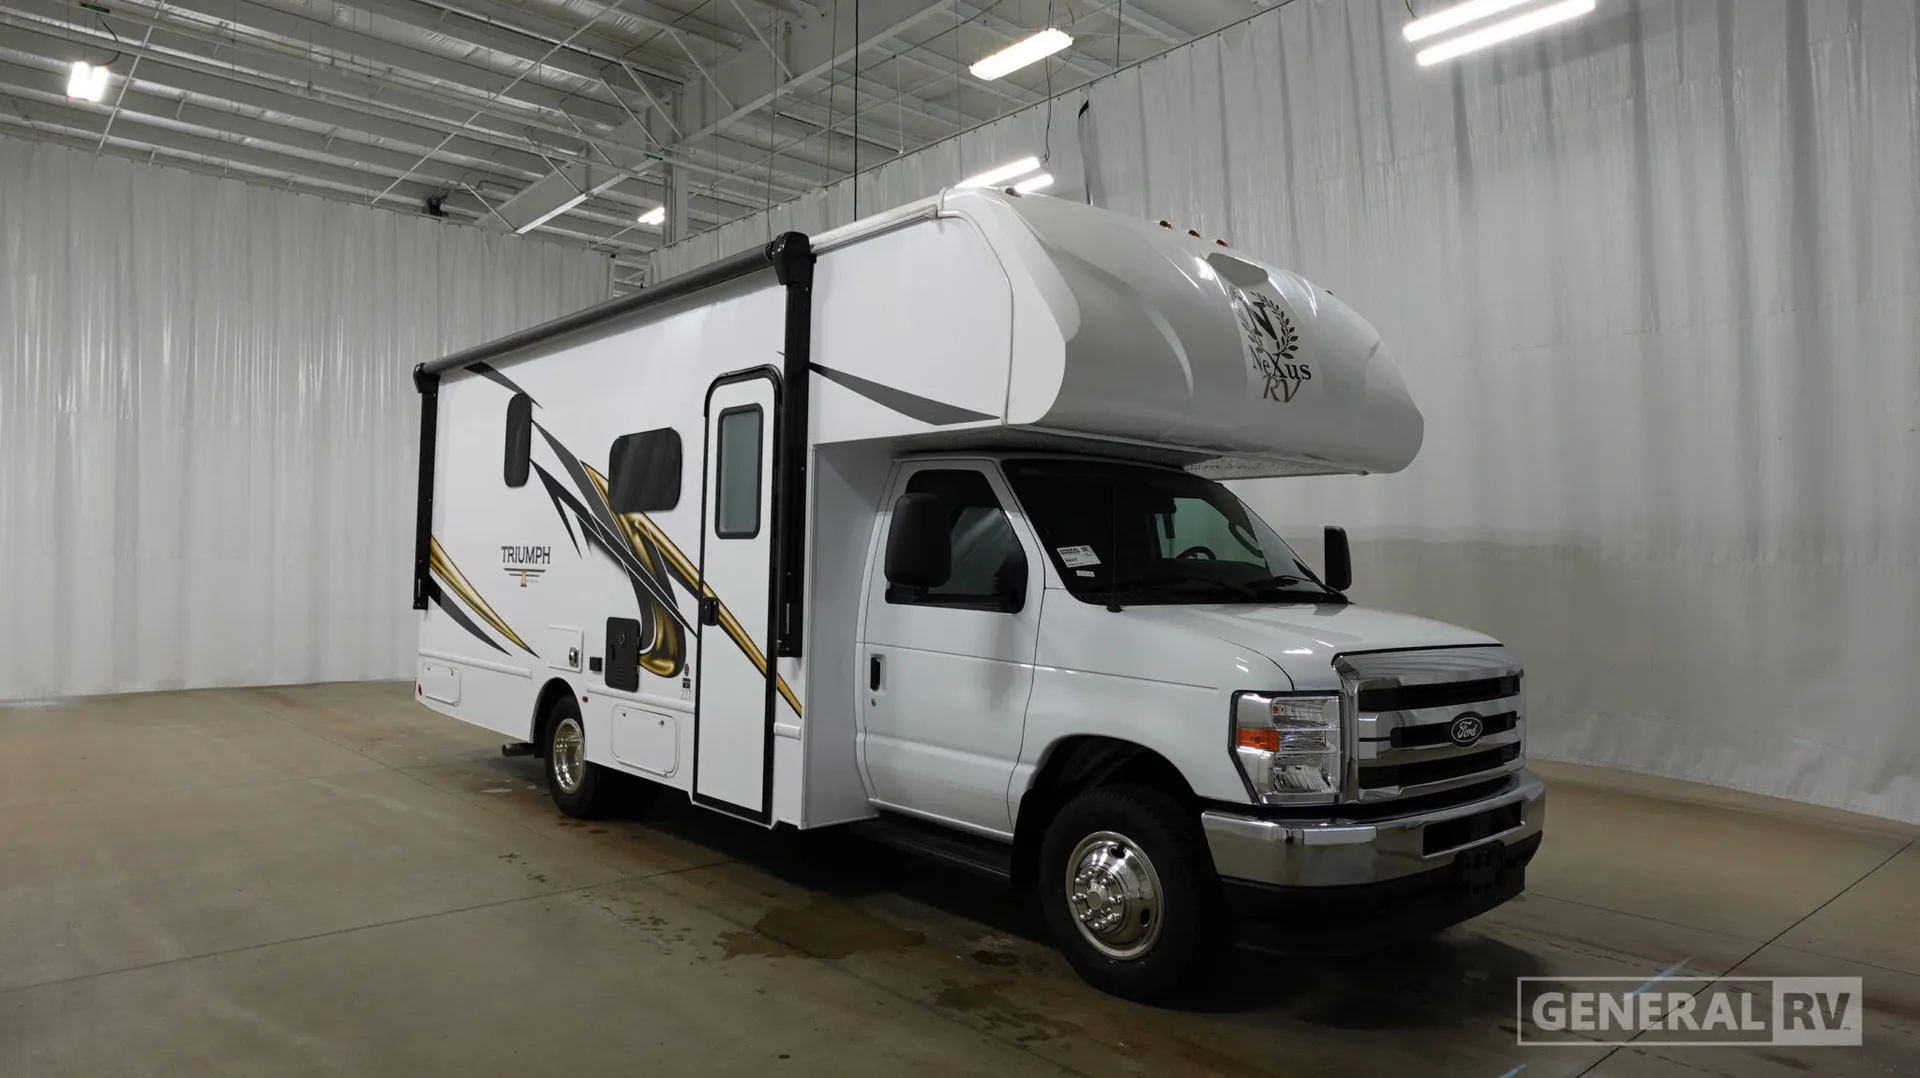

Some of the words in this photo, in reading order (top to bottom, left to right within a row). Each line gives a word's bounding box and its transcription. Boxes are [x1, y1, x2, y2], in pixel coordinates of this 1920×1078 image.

[1263, 375, 1302, 403] RV
[500, 546, 551, 564] TRIUMPH
[1457, 721, 1478, 739] Ford
